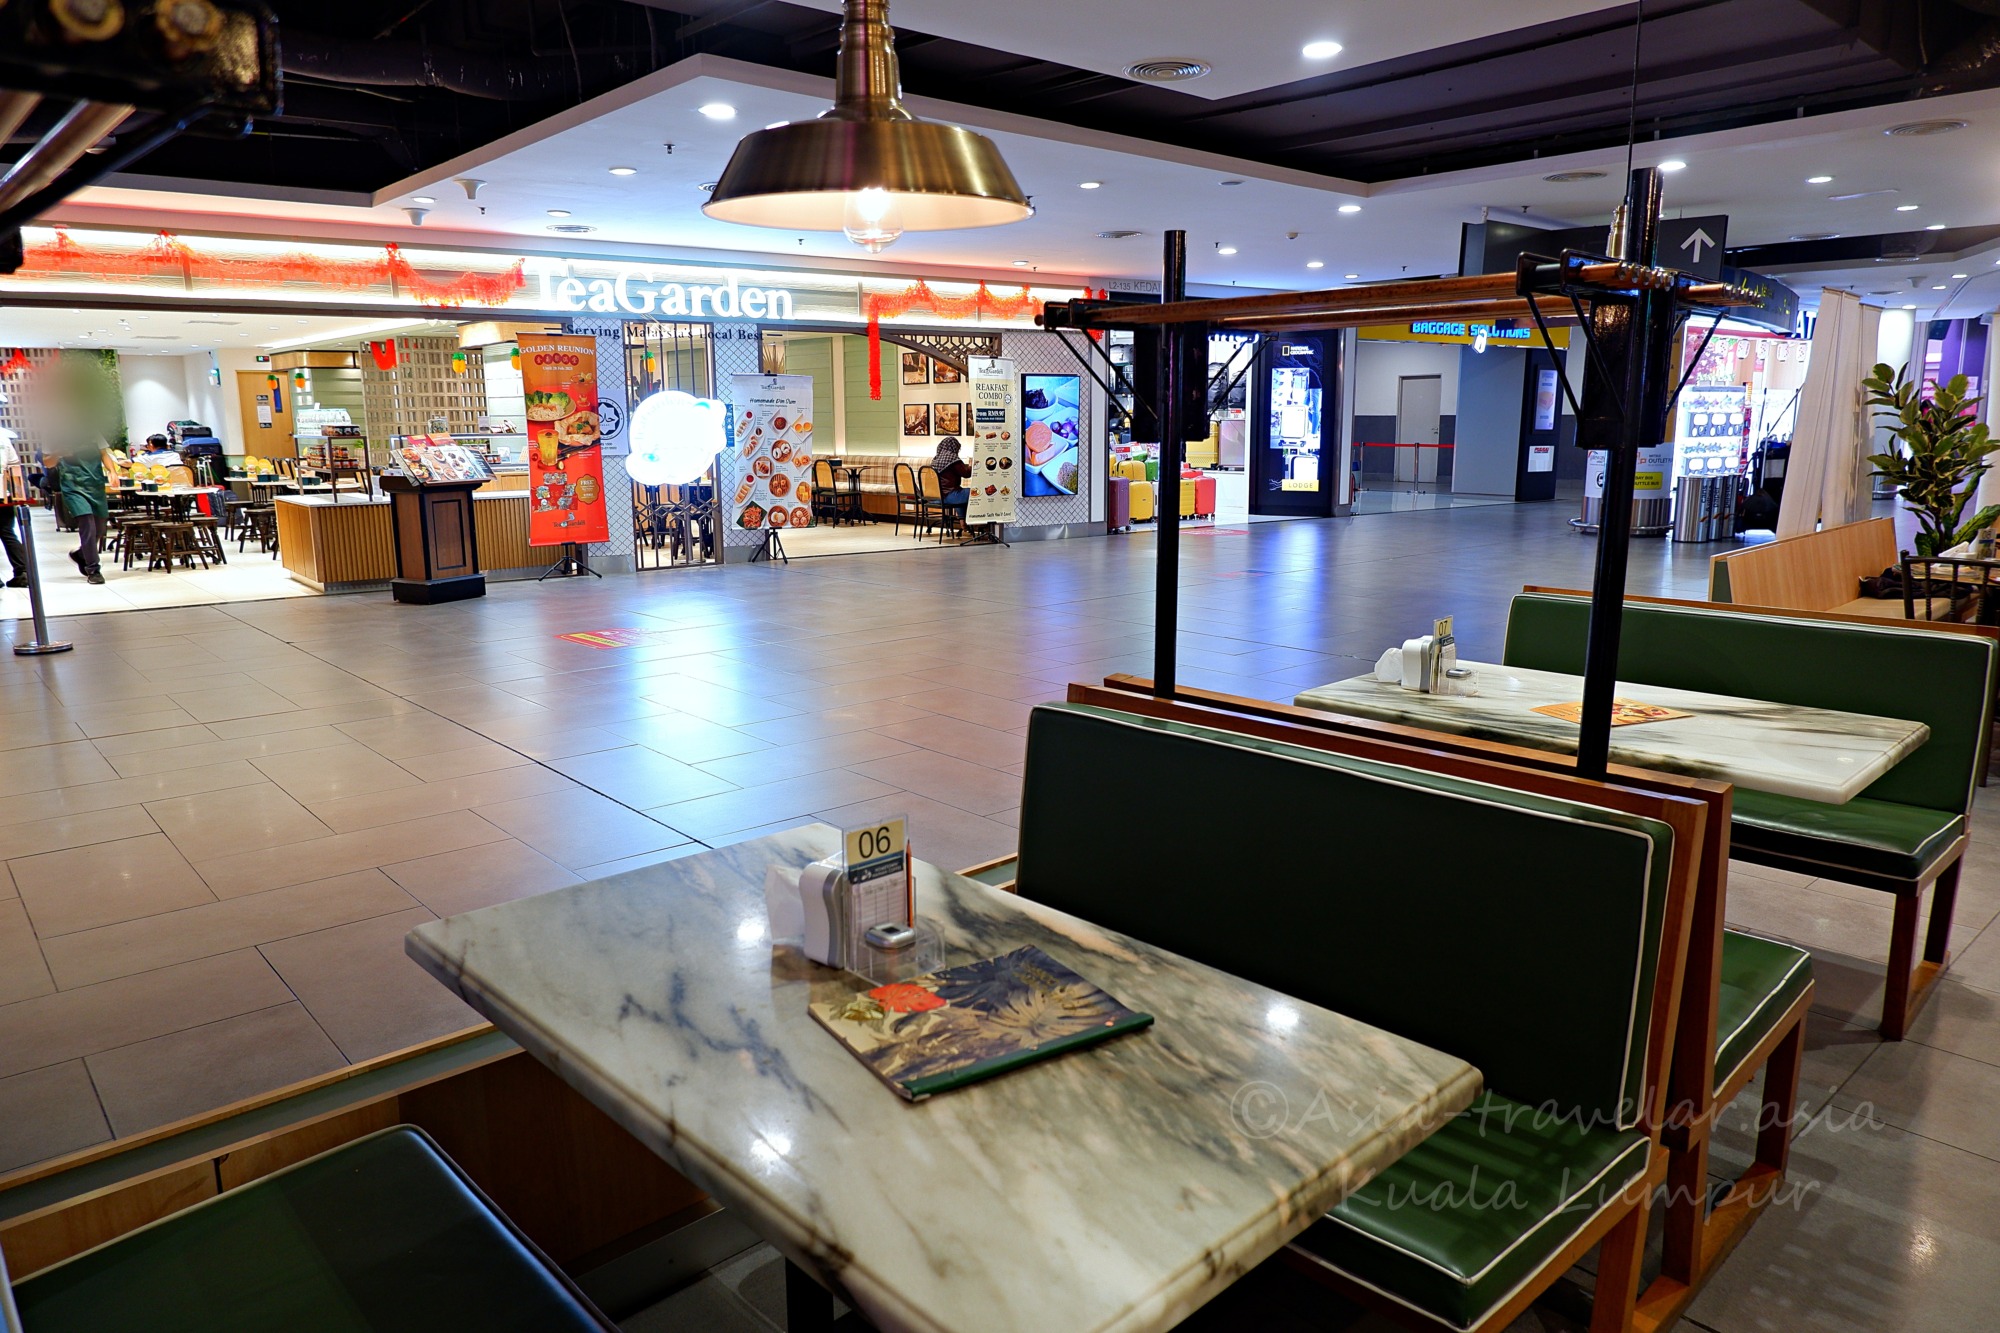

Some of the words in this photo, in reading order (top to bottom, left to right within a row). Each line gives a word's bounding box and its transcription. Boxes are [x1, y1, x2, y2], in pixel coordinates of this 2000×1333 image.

[534, 266, 796, 320] TeaGarden
[1108, 282, 1130, 290] L2-135
[566, 325, 620, 340] Serving
[626, 326, 693, 341] Malaysia's
[699, 328, 732, 340] Local
[738, 329, 764, 341] Best
[1411, 322, 1466, 336] BAGGAGE
[520, 344, 555, 354] GOLDEN
[558, 344, 594, 356] REUNION
[976, 383, 1008, 392] REAKFAST
[978, 392, 1002, 400] COMBO
[1438, 620, 1448, 636] 07
[858, 826, 891, 858] 06
